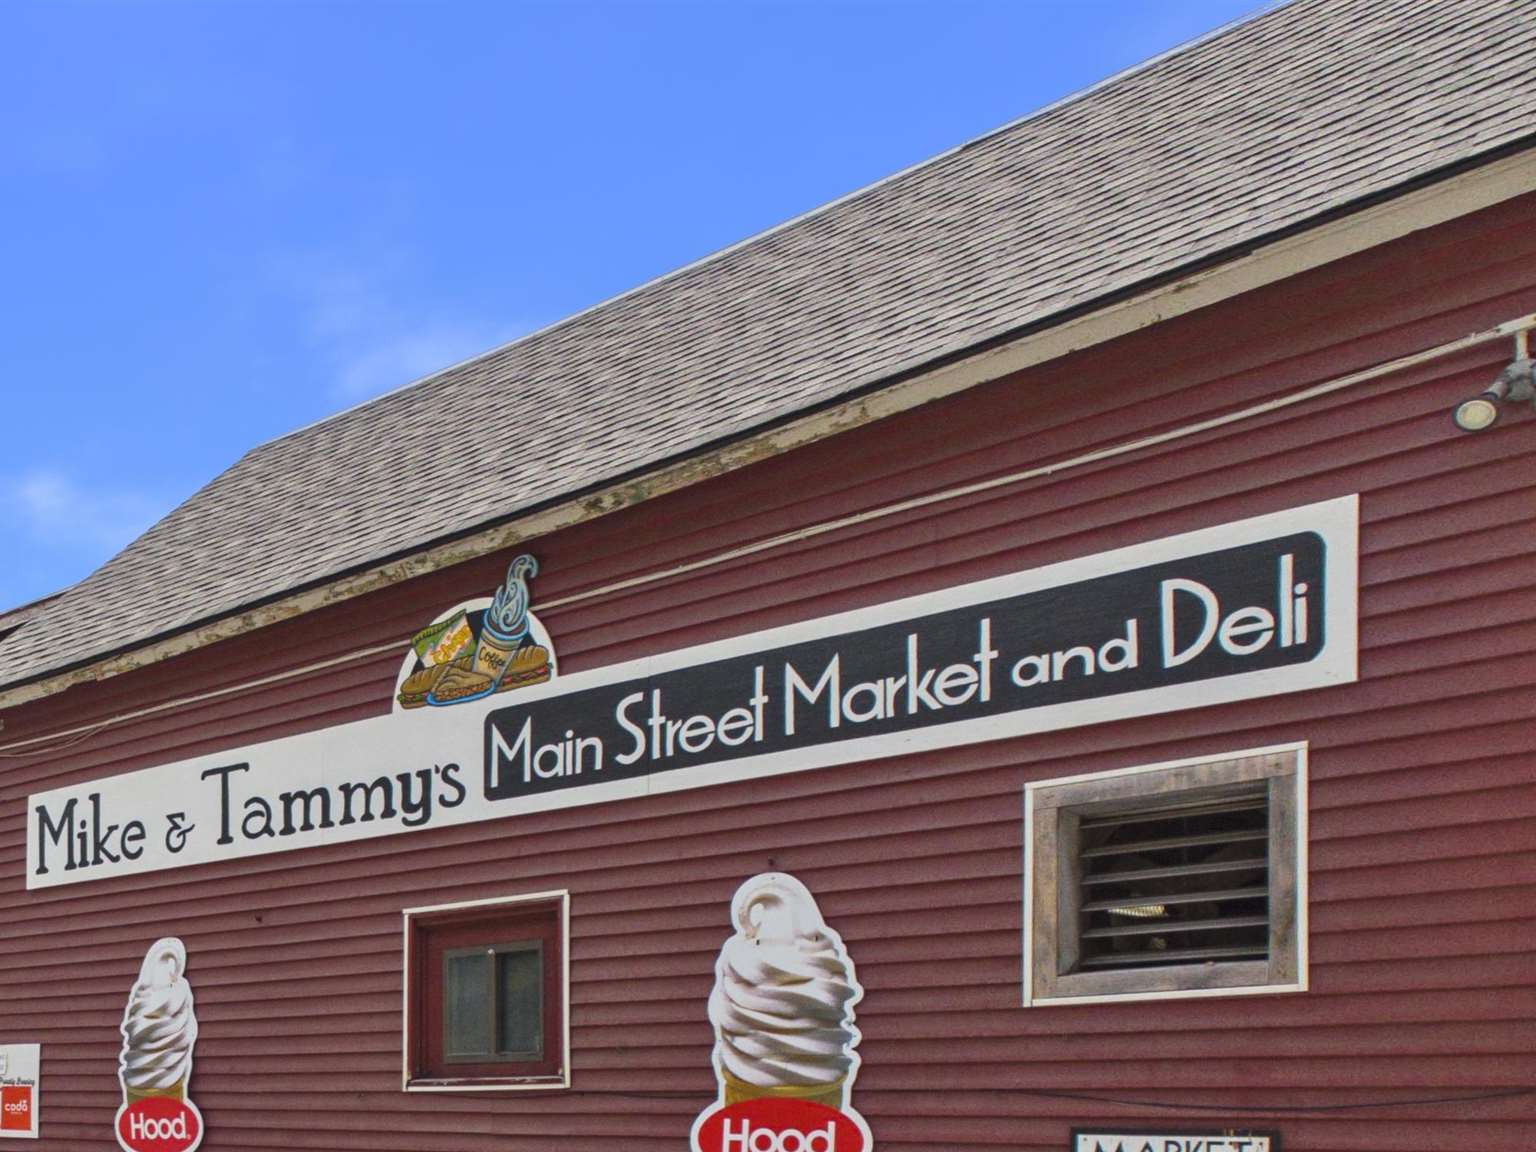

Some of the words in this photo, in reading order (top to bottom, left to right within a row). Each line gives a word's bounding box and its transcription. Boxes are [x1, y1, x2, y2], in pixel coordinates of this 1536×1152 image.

[35, 792, 147, 875] Mike
[165, 811, 195, 853] &
[201, 762, 467, 846] Tammy's
[490, 715, 603, 789] Main
[615, 665, 769, 765] Street
[784, 617, 999, 736] Market
[1012, 618, 1138, 688] and
[1161, 553, 1309, 669] Deli
[129, 1111, 187, 1140] Hood
